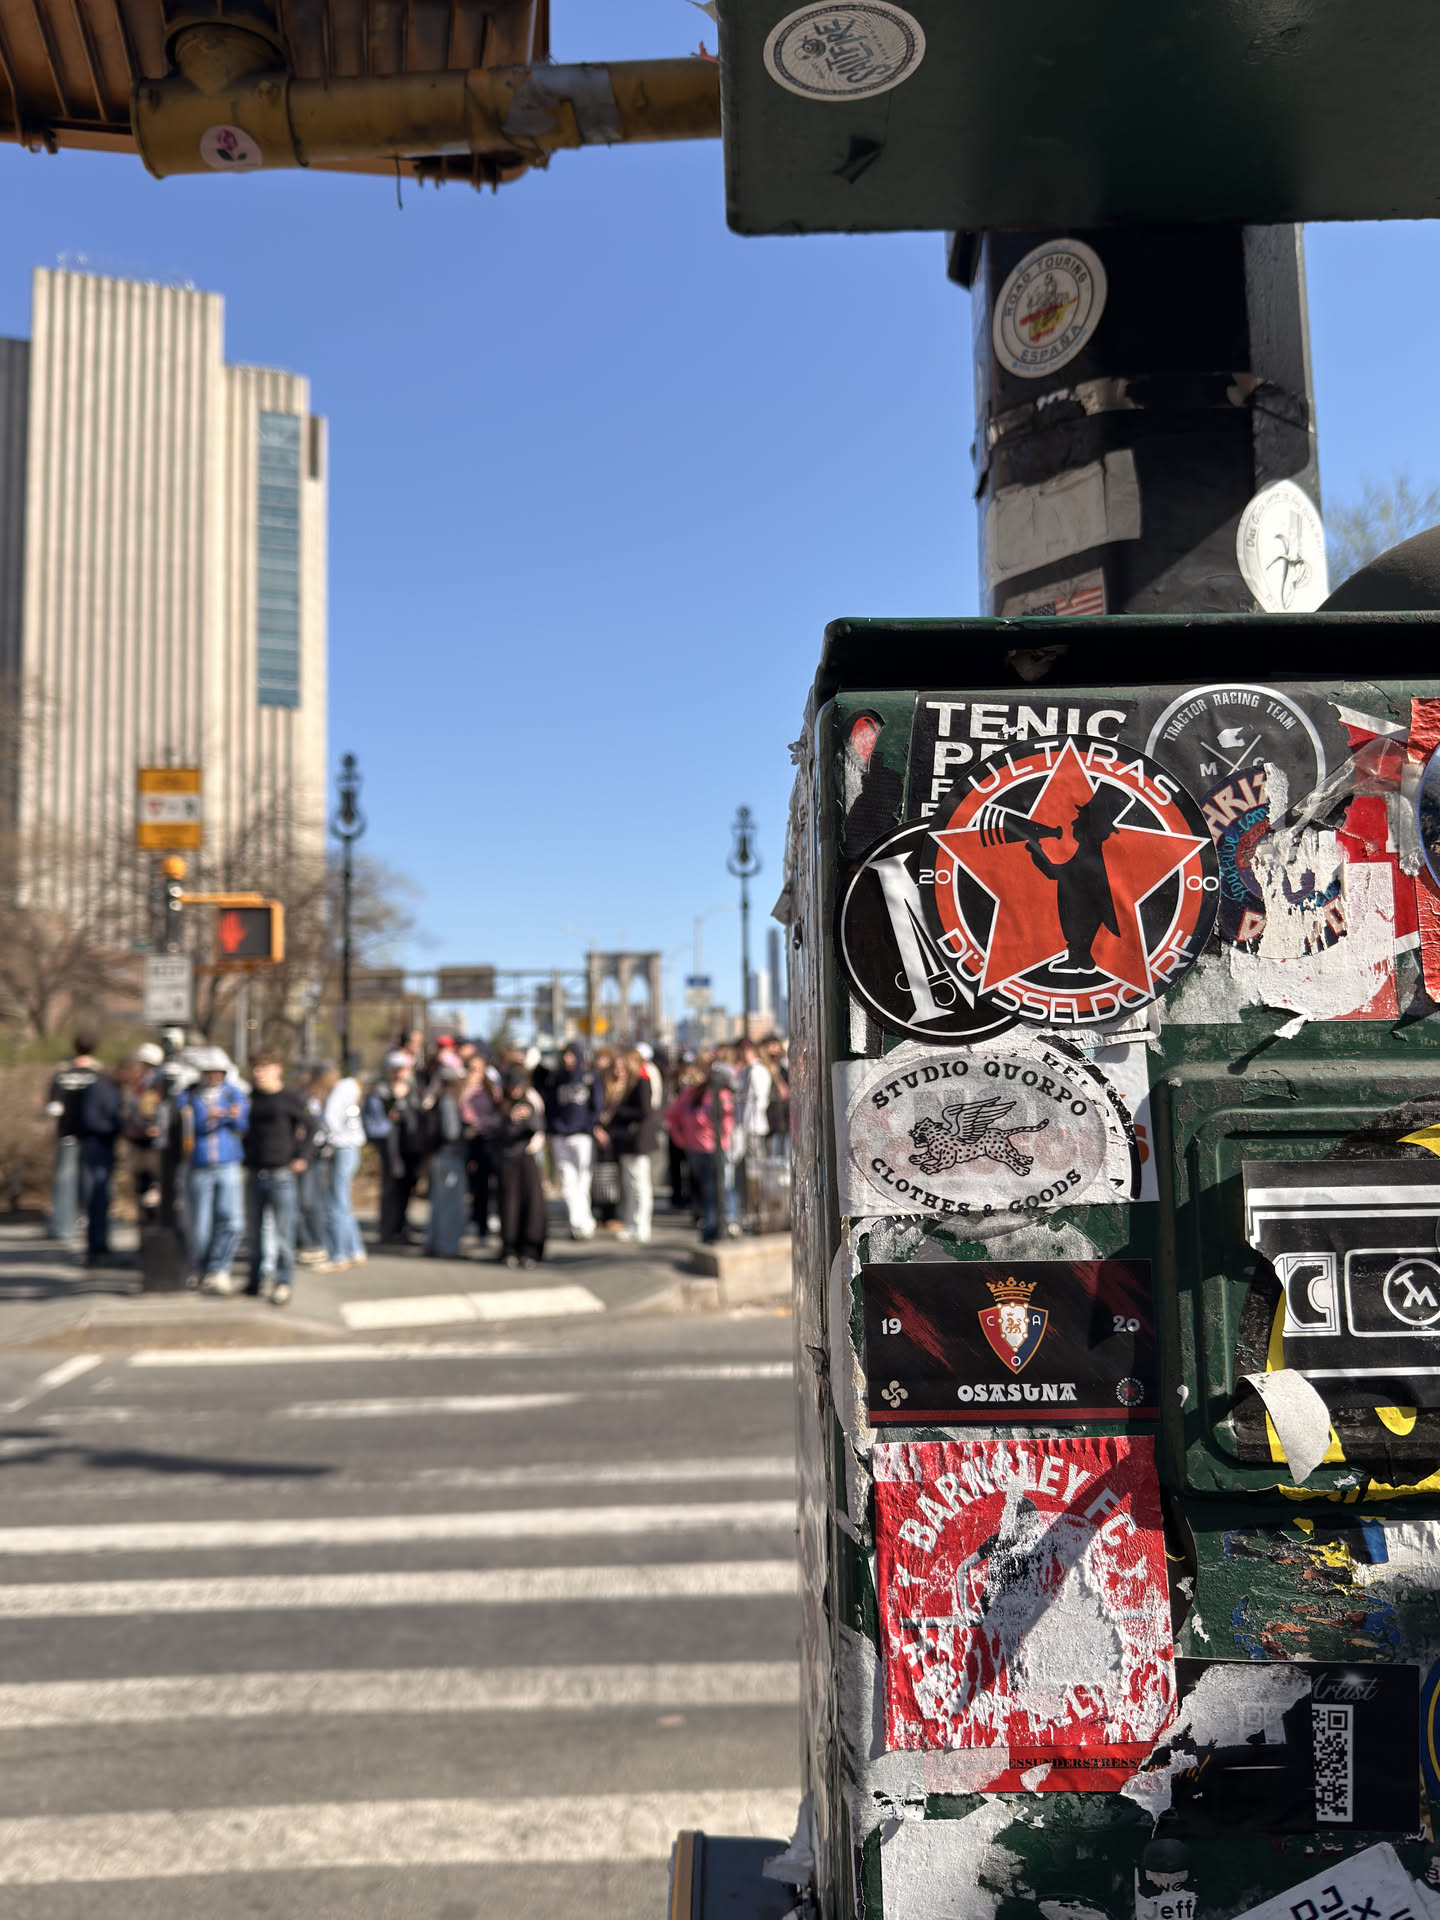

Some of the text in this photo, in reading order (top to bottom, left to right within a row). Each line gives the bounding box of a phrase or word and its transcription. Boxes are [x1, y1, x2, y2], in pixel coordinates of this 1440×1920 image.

[1038, 256, 1088, 284] TOURING
[926, 701, 1127, 742] TENIC
[1162, 691, 1298, 743] TRACTOR RACING TEAM
[968, 741, 1180, 805] ULTRAS
[1199, 762, 1218, 777] M
[919, 868, 1218, 892] 20 00
[872, 1060, 1088, 1117] STUDIO QUORPO
[871, 1158, 1083, 1217] CLOTHES & GOODS
[881, 1317, 902, 1335] 19
[1112, 1315, 1141, 1333] 20
[957, 1382, 1078, 1403] OSASUNA
[1084, 1488, 1137, 1547] FC
